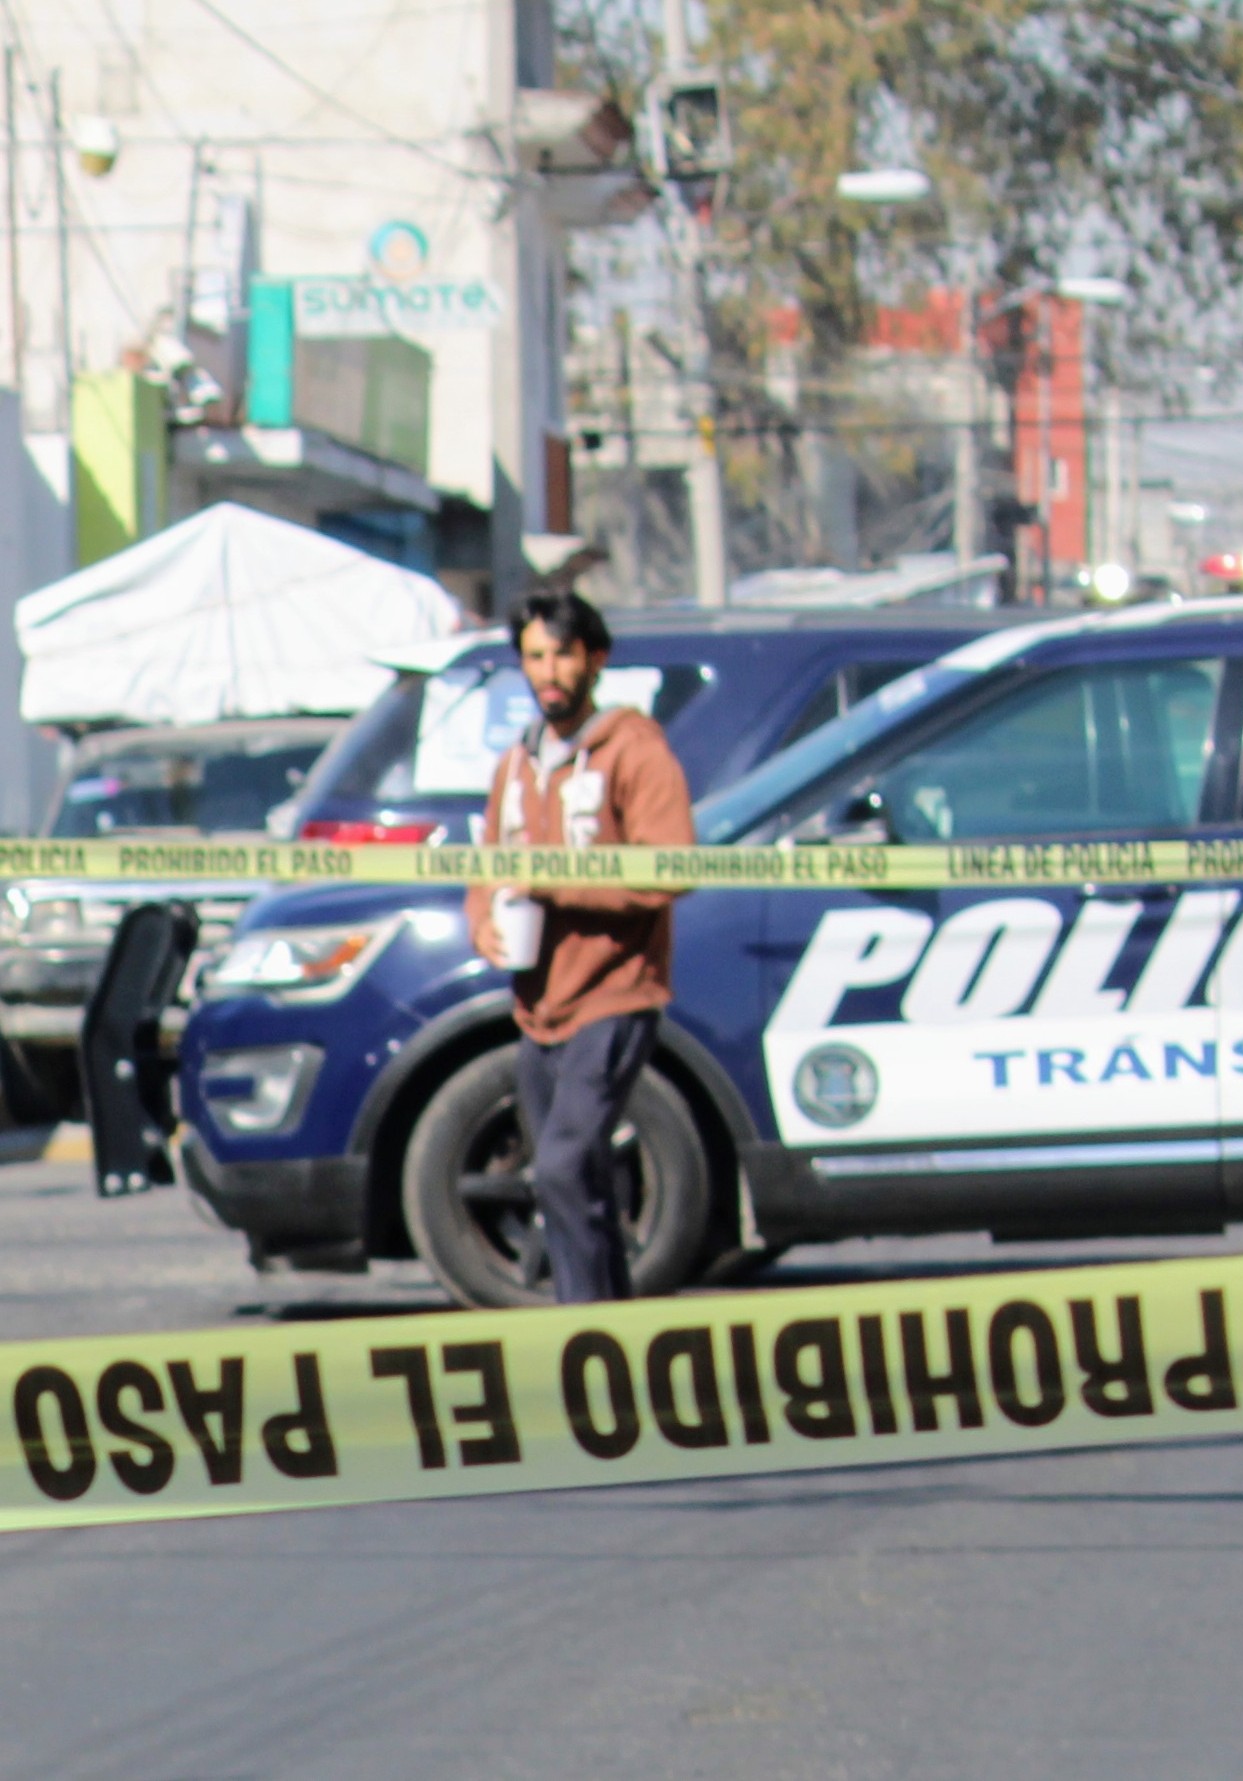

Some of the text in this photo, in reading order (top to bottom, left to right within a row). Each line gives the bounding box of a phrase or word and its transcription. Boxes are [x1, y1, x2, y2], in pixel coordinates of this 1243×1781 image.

[119, 846, 248, 875] PROHIBIDO
[258, 848, 278, 875] EL
[292, 848, 350, 875] PASO
[416, 850, 482, 878] LINEA
[494, 850, 520, 878] DE
[531, 850, 624, 879] POLICIA
[655, 850, 785, 880] PROHIBIDO
[793, 850, 817, 880] EL
[827, 850, 887, 880] PASO
[948, 844, 1015, 878] LINEA
[1024, 844, 1051, 877] DE
[1062, 841, 1154, 876] POLICIA
[12, 1352, 340, 1502] PASO
[369, 1341, 523, 1470] EL
[560, 1289, 1238, 1461] PROHIBIDO
